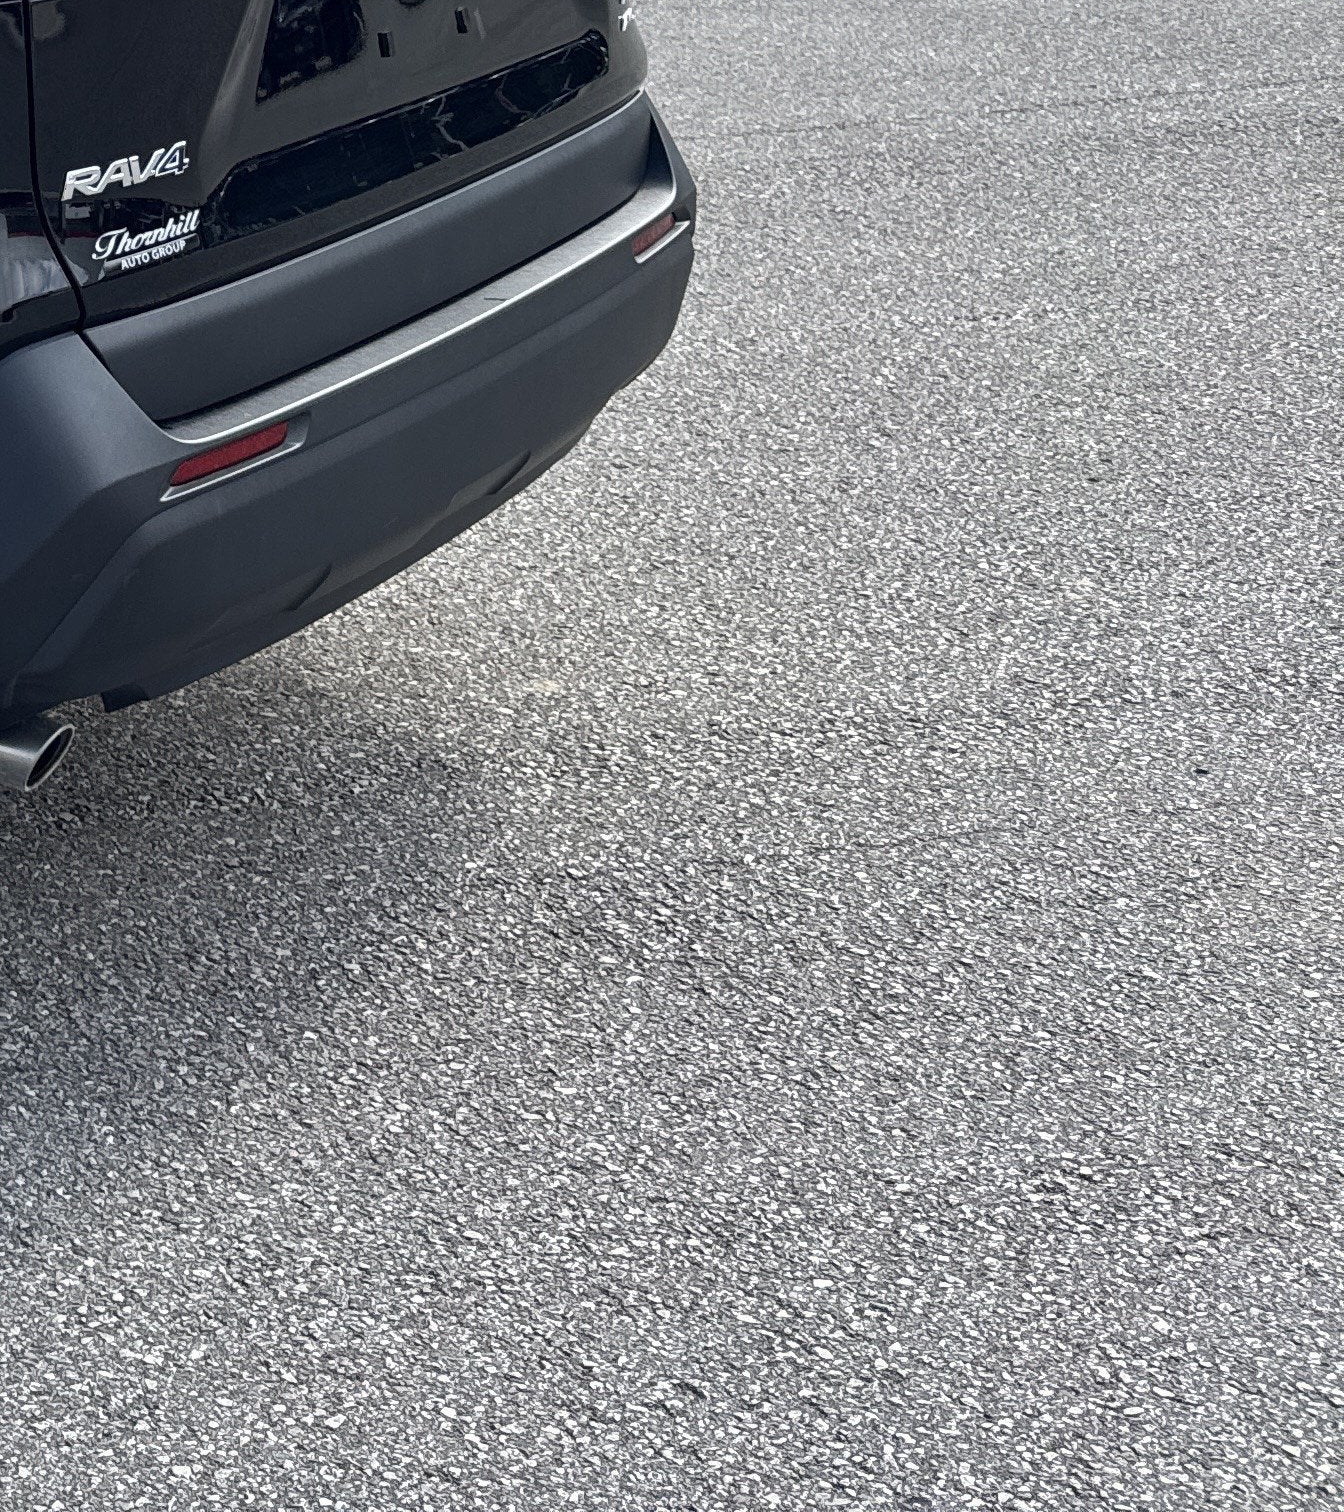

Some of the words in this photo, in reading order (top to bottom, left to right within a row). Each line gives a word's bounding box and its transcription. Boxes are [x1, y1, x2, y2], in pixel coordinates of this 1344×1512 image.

[61, 140, 190, 201] RAV4
[91, 208, 201, 260] Thornhill
[120, 251, 151, 271] AUTO
[150, 240, 187, 264] GROUP
